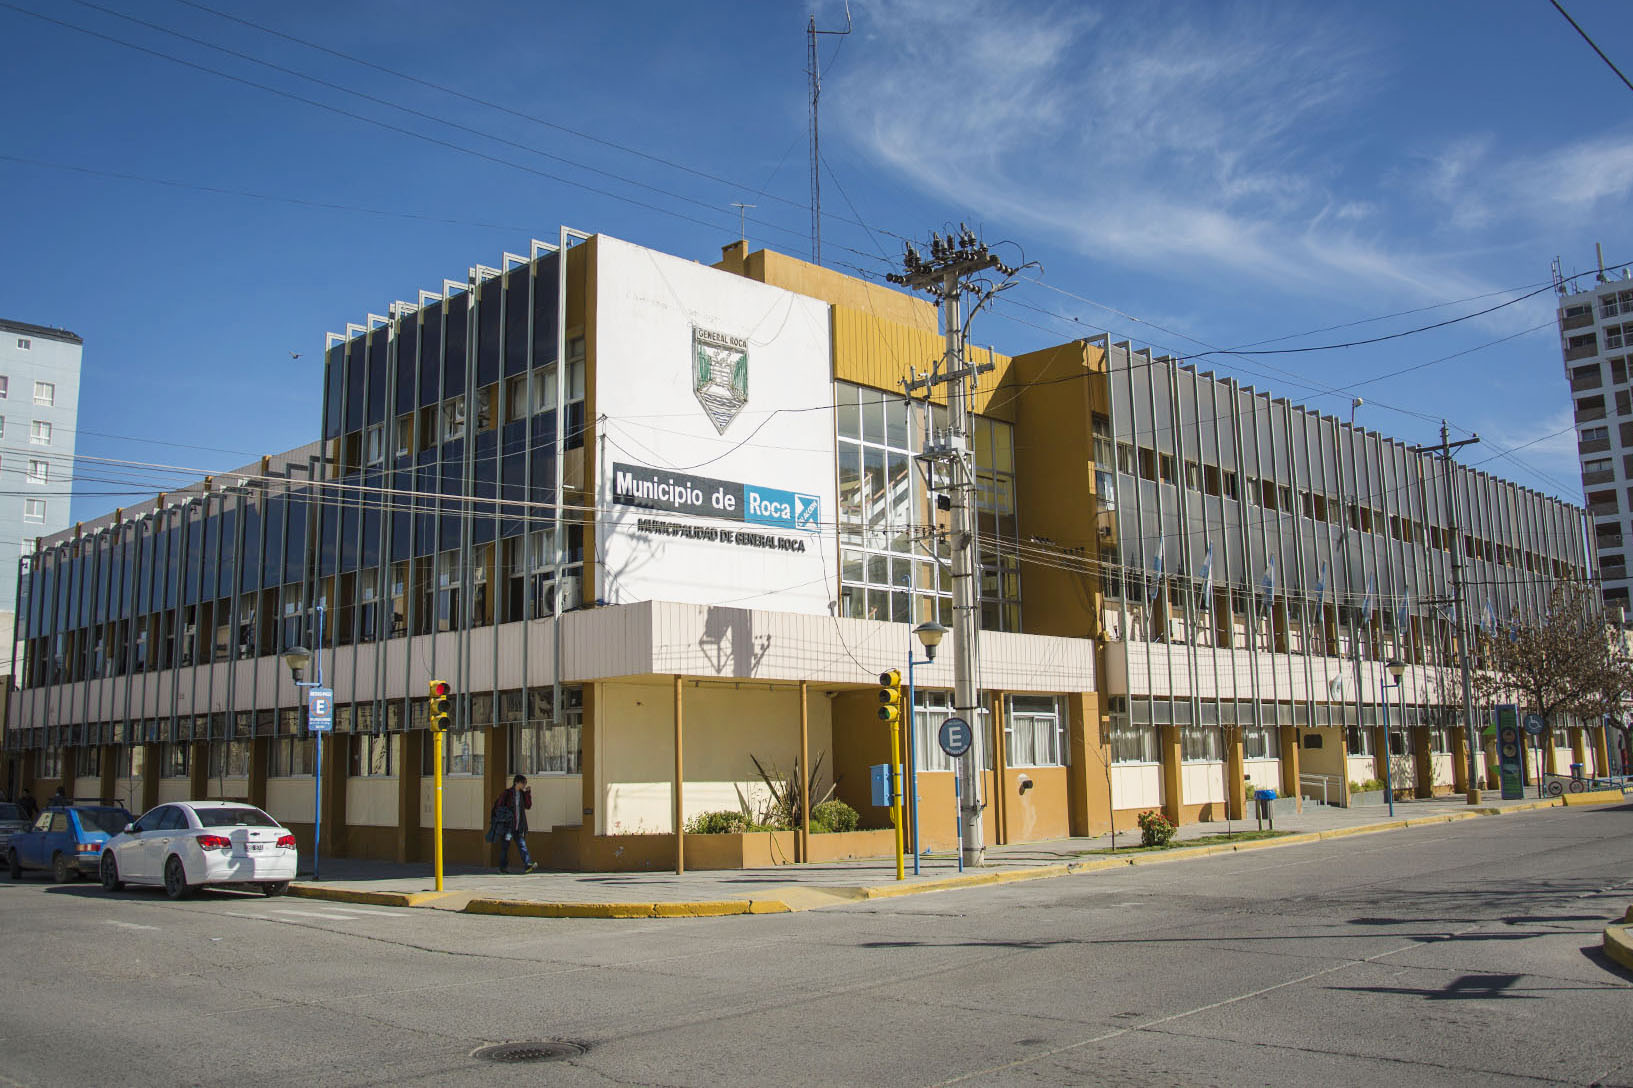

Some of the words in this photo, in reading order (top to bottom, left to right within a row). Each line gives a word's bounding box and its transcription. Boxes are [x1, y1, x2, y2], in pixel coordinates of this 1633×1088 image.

[698, 328, 729, 344] GENERAL
[730, 336, 747, 348] ROCA
[617, 471, 703, 506] Municipio
[711, 488, 735, 510] de
[750, 492, 791, 519] Roca
[637, 518, 718, 541] MUNICIPALIDAD
[719, 529, 734, 543] DE
[735, 532, 778, 550] GENERAL
[777, 536, 806, 553] ROCA
[316, 700, 324, 714] E
[949, 727, 961, 746] E
